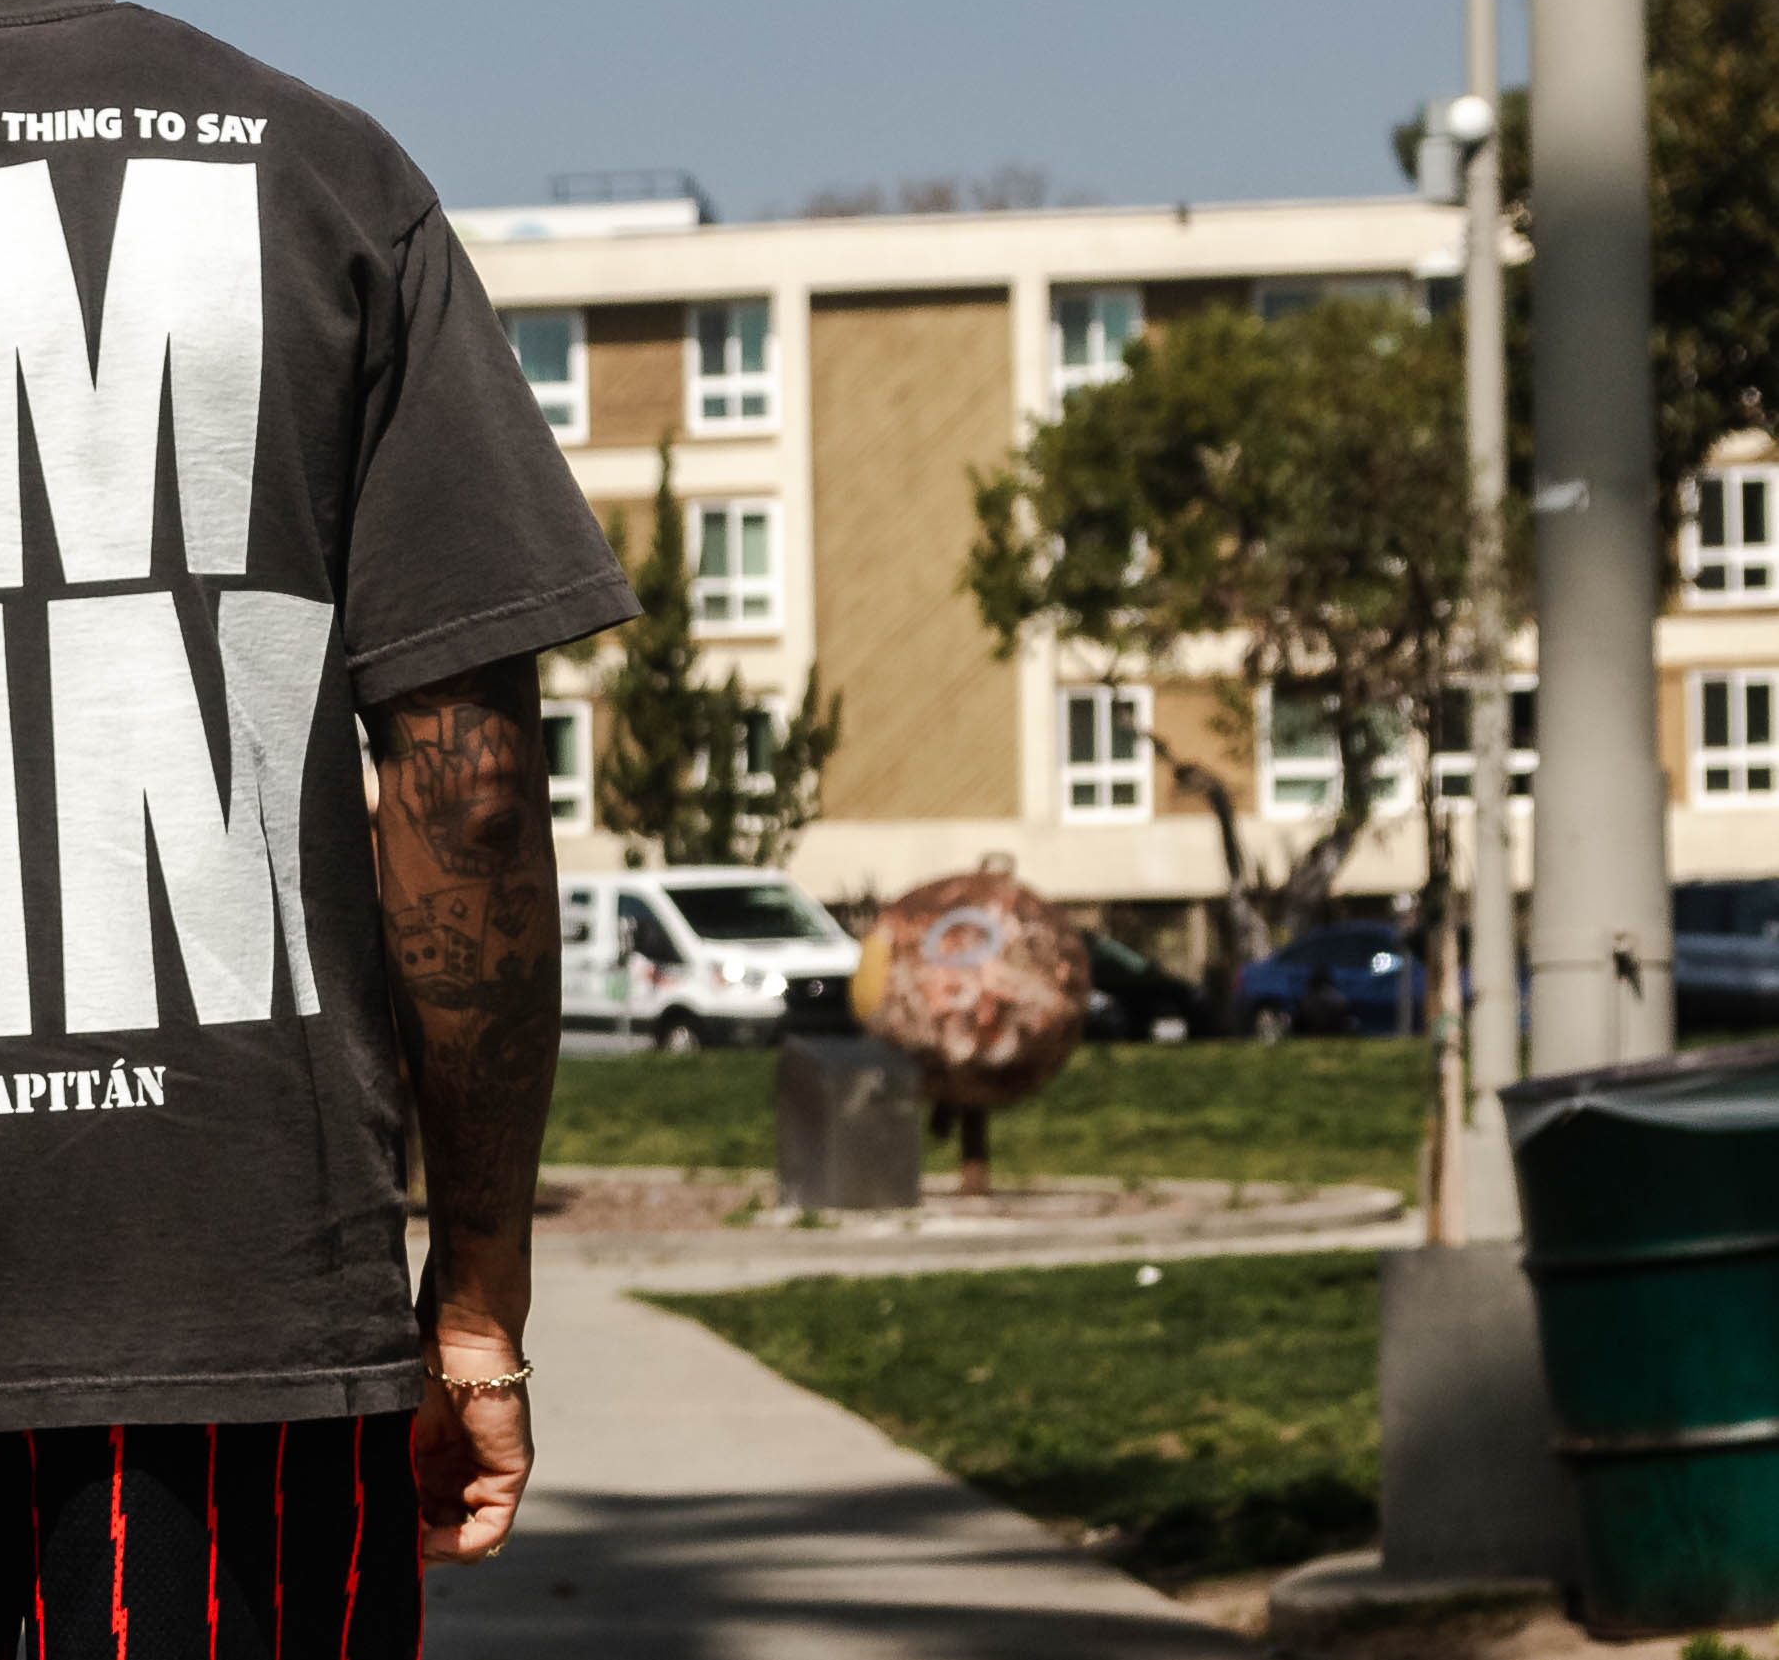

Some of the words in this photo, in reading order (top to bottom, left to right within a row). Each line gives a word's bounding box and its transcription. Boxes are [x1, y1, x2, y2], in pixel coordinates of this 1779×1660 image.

[1, 107, 123, 142] THING
[133, 107, 186, 142] TO
[196, 113, 268, 145] SAY
